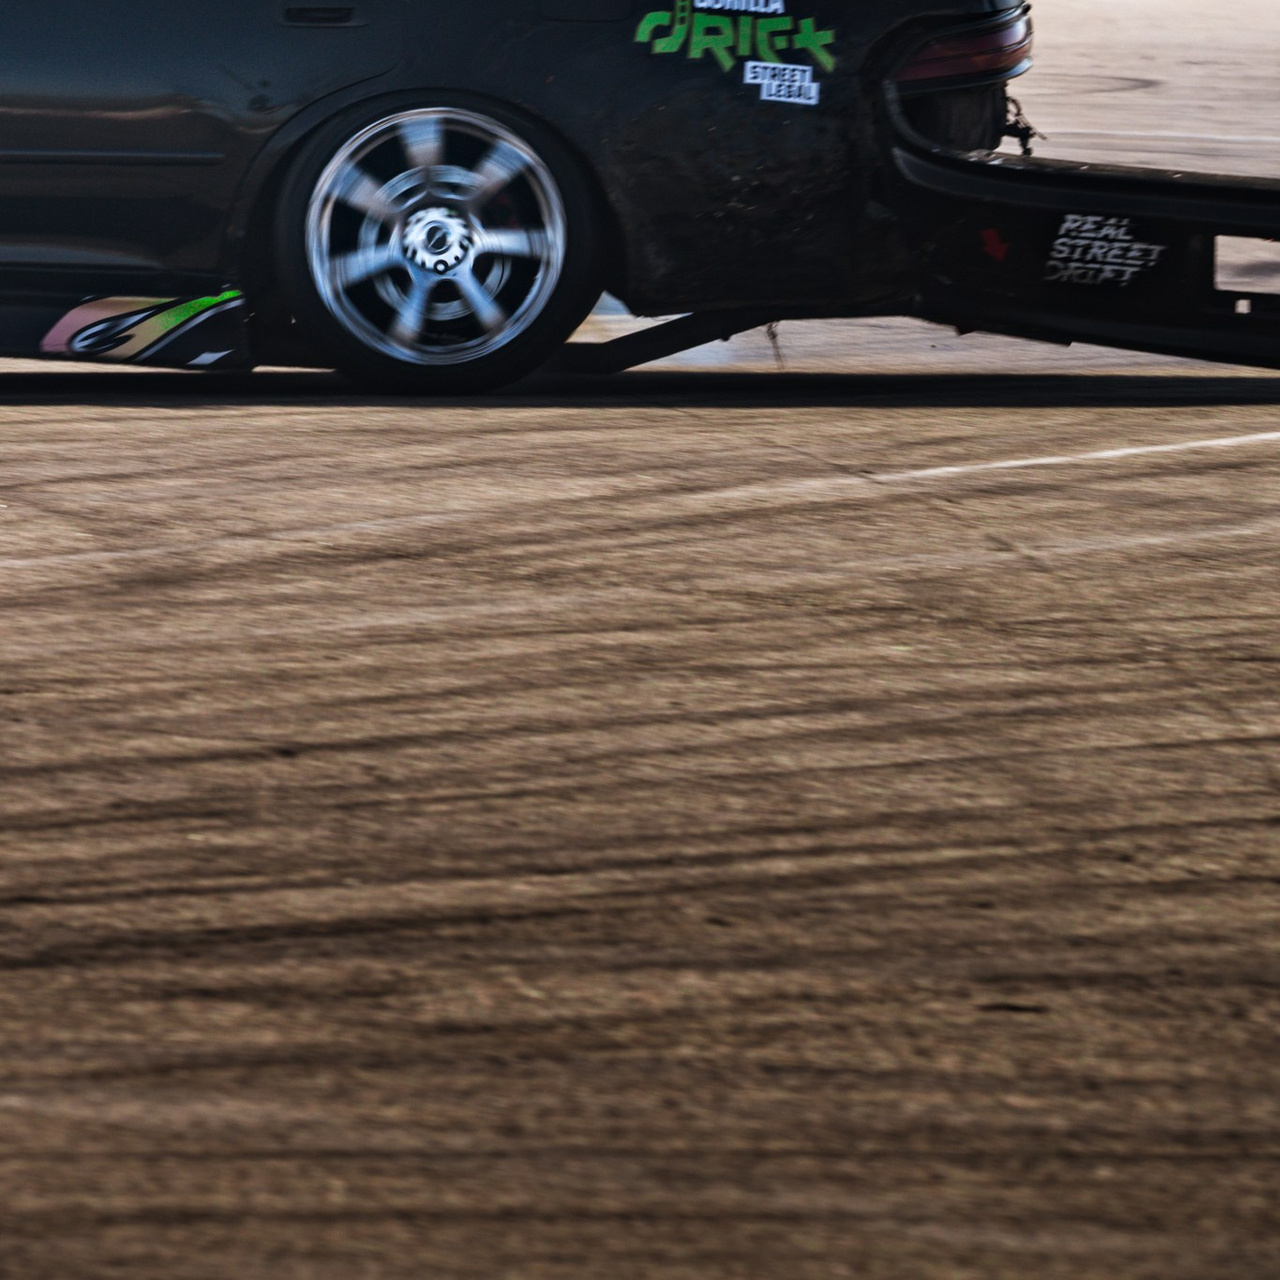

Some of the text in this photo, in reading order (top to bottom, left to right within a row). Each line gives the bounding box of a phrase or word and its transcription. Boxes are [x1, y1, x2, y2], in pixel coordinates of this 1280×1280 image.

[749, 64, 811, 83] STREET
[766, 83, 815, 100] LEGAL
[1058, 214, 1133, 239] REAL
[1050, 238, 1166, 266] STREET
[1043, 260, 1141, 286] DRIFT
